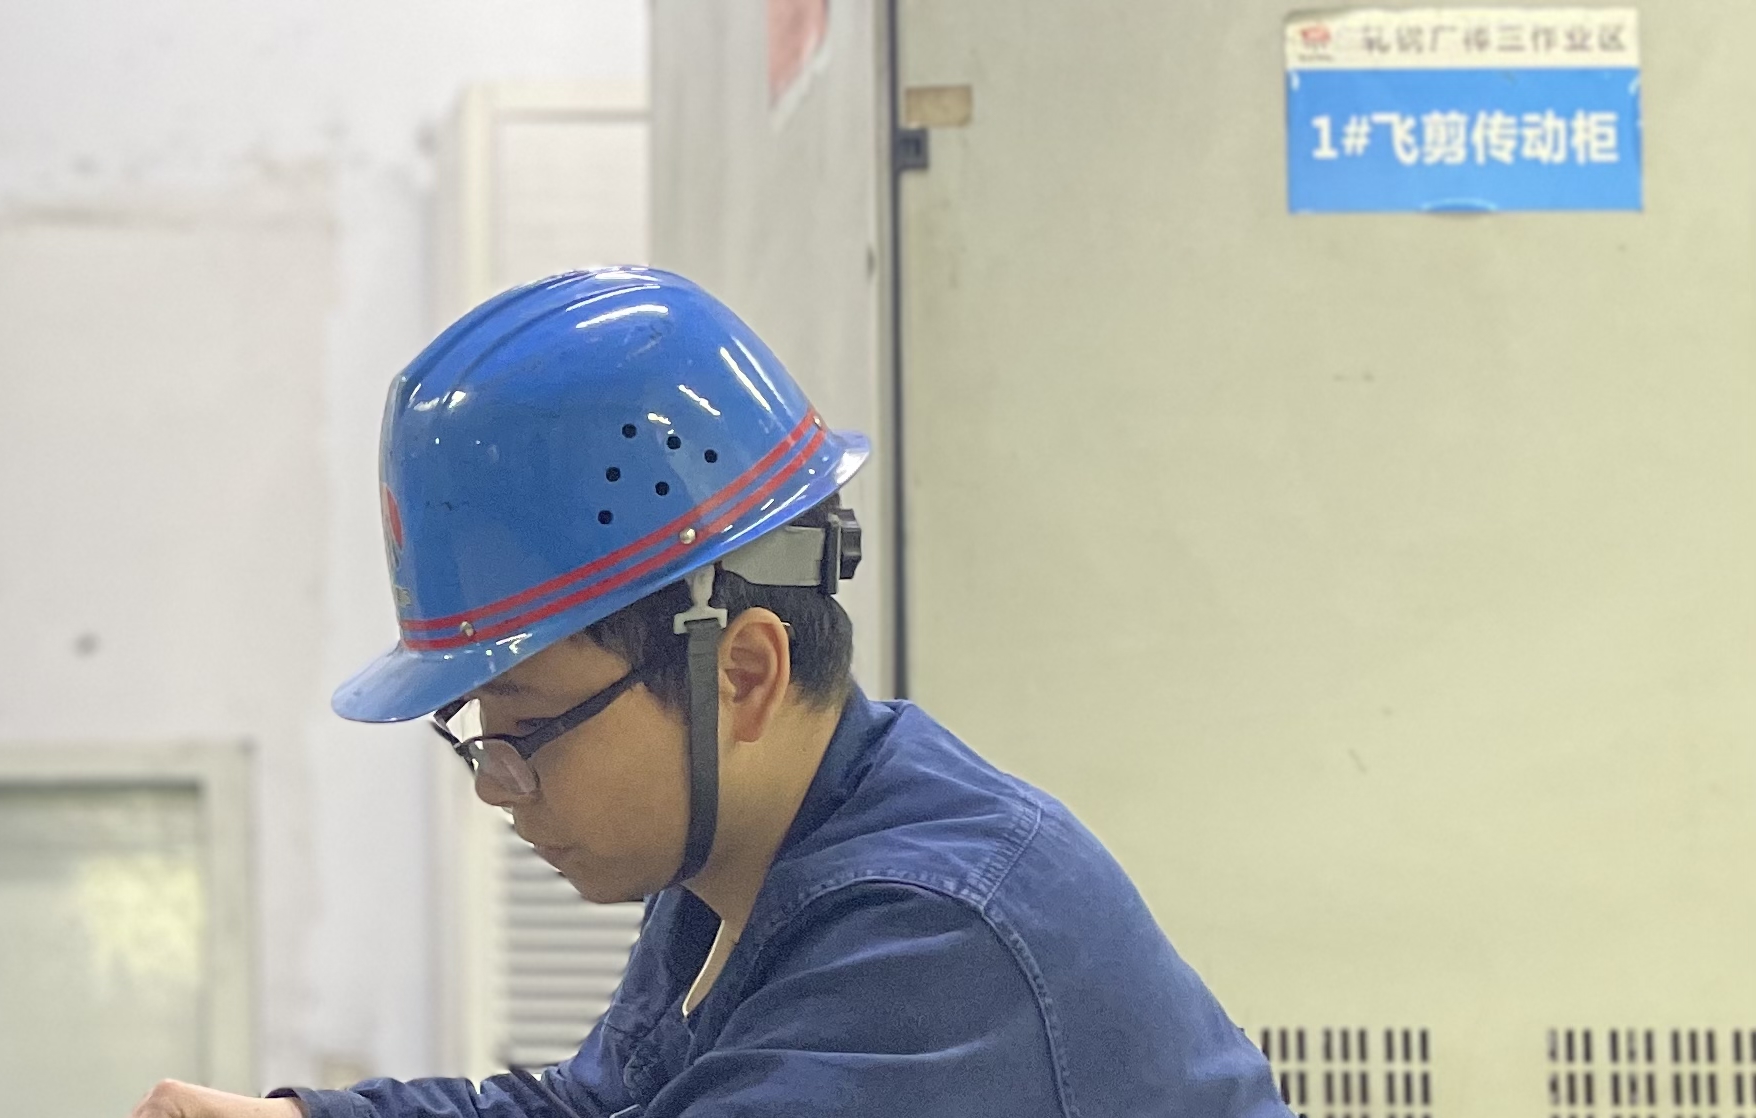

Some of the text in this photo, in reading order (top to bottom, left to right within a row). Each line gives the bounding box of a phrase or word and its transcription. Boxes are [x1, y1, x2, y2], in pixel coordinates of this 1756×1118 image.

[1310, 109, 1620, 166] 1#飞剪传动柜
